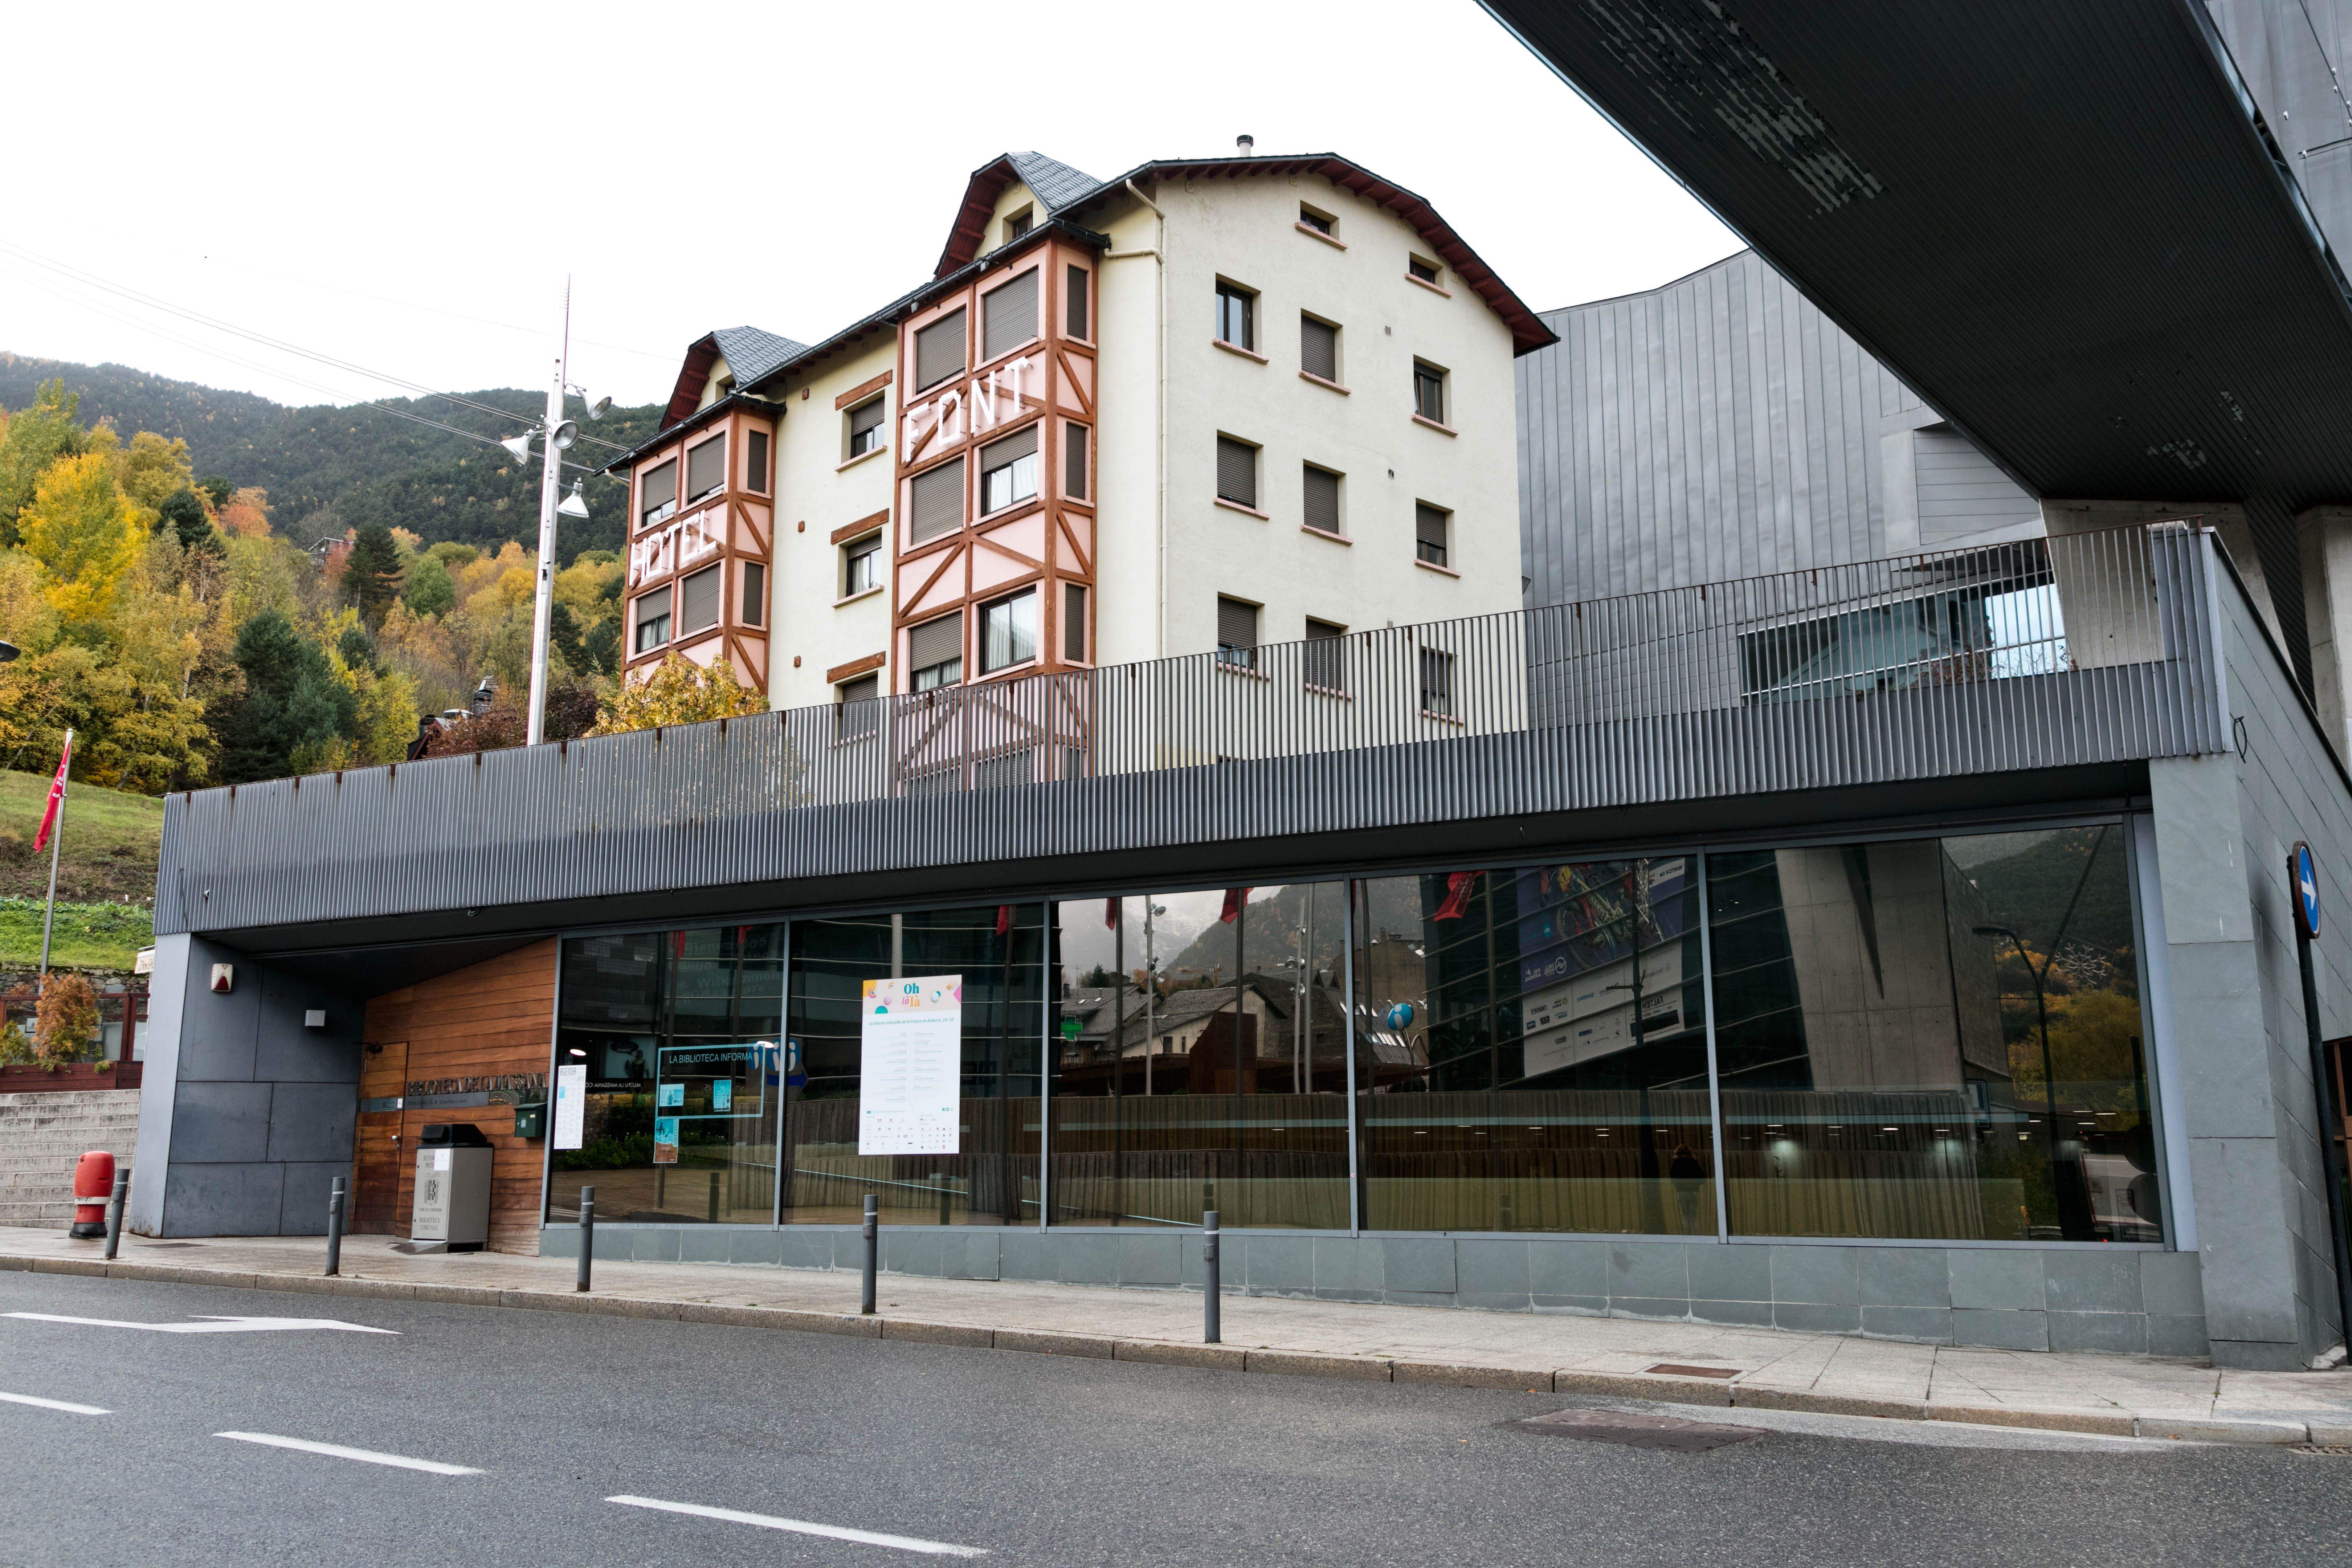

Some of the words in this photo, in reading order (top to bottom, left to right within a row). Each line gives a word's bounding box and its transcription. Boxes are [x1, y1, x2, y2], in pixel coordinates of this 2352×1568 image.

[906, 356, 1028, 462] FONT
[629, 510, 716, 586] HOTEL
[904, 983, 919, 994] Oh
[902, 995, 909, 1005] là
[910, 995, 920, 1007] là
[679, 1054, 719, 1063] BIBLIOTECA
[720, 1052, 753, 1062] INFORMA
[560, 1067, 576, 1076] AGENDA
[407, 1078, 462, 1096] BIBLIOTECA
[464, 1076, 478, 1093] DE
[478, 1076, 492, 1091] LA
[494, 1073, 546, 1091] MASSANA
